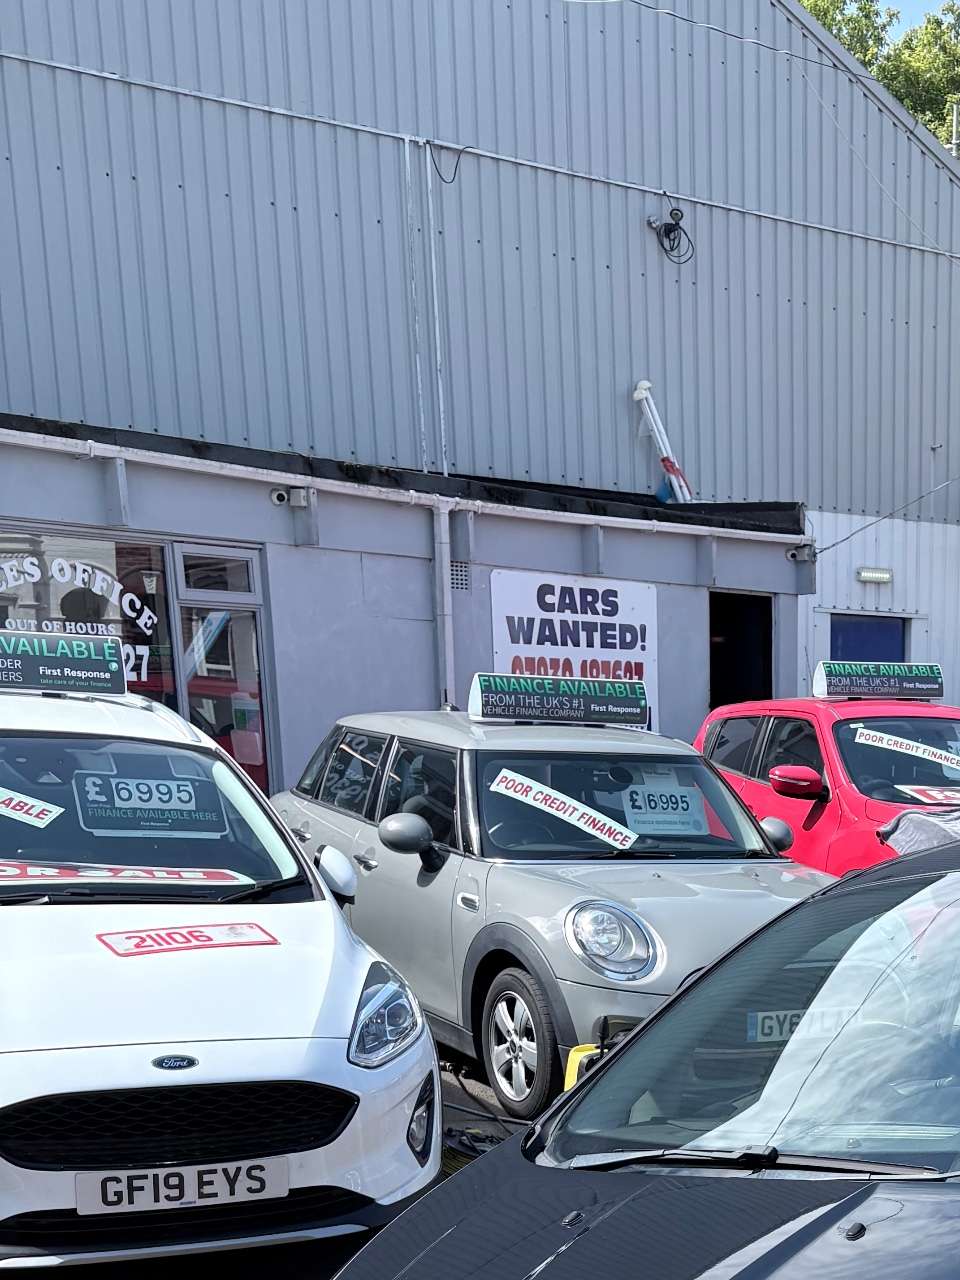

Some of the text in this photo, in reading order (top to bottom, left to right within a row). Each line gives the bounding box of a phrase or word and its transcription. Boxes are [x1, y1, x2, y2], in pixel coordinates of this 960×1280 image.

[0, 557, 158, 636] ES OFFICE
[536, 583, 619, 617] CARS
[5, 618, 116, 635] OUT OF HOURS
[505, 615, 647, 651] WANTED!
[0, 636, 118, 661] VAILABLE
[123, 644, 150, 682] 27
[823, 663, 942, 677] FINANCE AVAILABLE
[0, 671, 23, 682] ERS
[39, 667, 111, 679] First Response
[827, 677, 851, 686] FROM
[853, 677, 869, 686] THE
[480, 676, 646, 698] FINANCE AVAILABLE
[482, 693, 585, 710] FROM THE UK'S #1
[591, 704, 641, 715] First Response
[482, 705, 514, 715] VEHICLE
[516, 707, 547, 716] FINANCE
[549, 708, 585, 718] COMPANY
[858, 731, 884, 745] POOR
[886, 738, 921, 754] CREDIT
[88, 807, 219, 821] FINANCE AVAILABLE HERE
[496, 774, 633, 848] POOR CREDIT FINANCE
[76, 867, 208, 879] SALE
[124, 930, 214, 949] 21106
[162, 1057, 189, 1068] Ford
[100, 1164, 266, 1206] GF19 EYS
